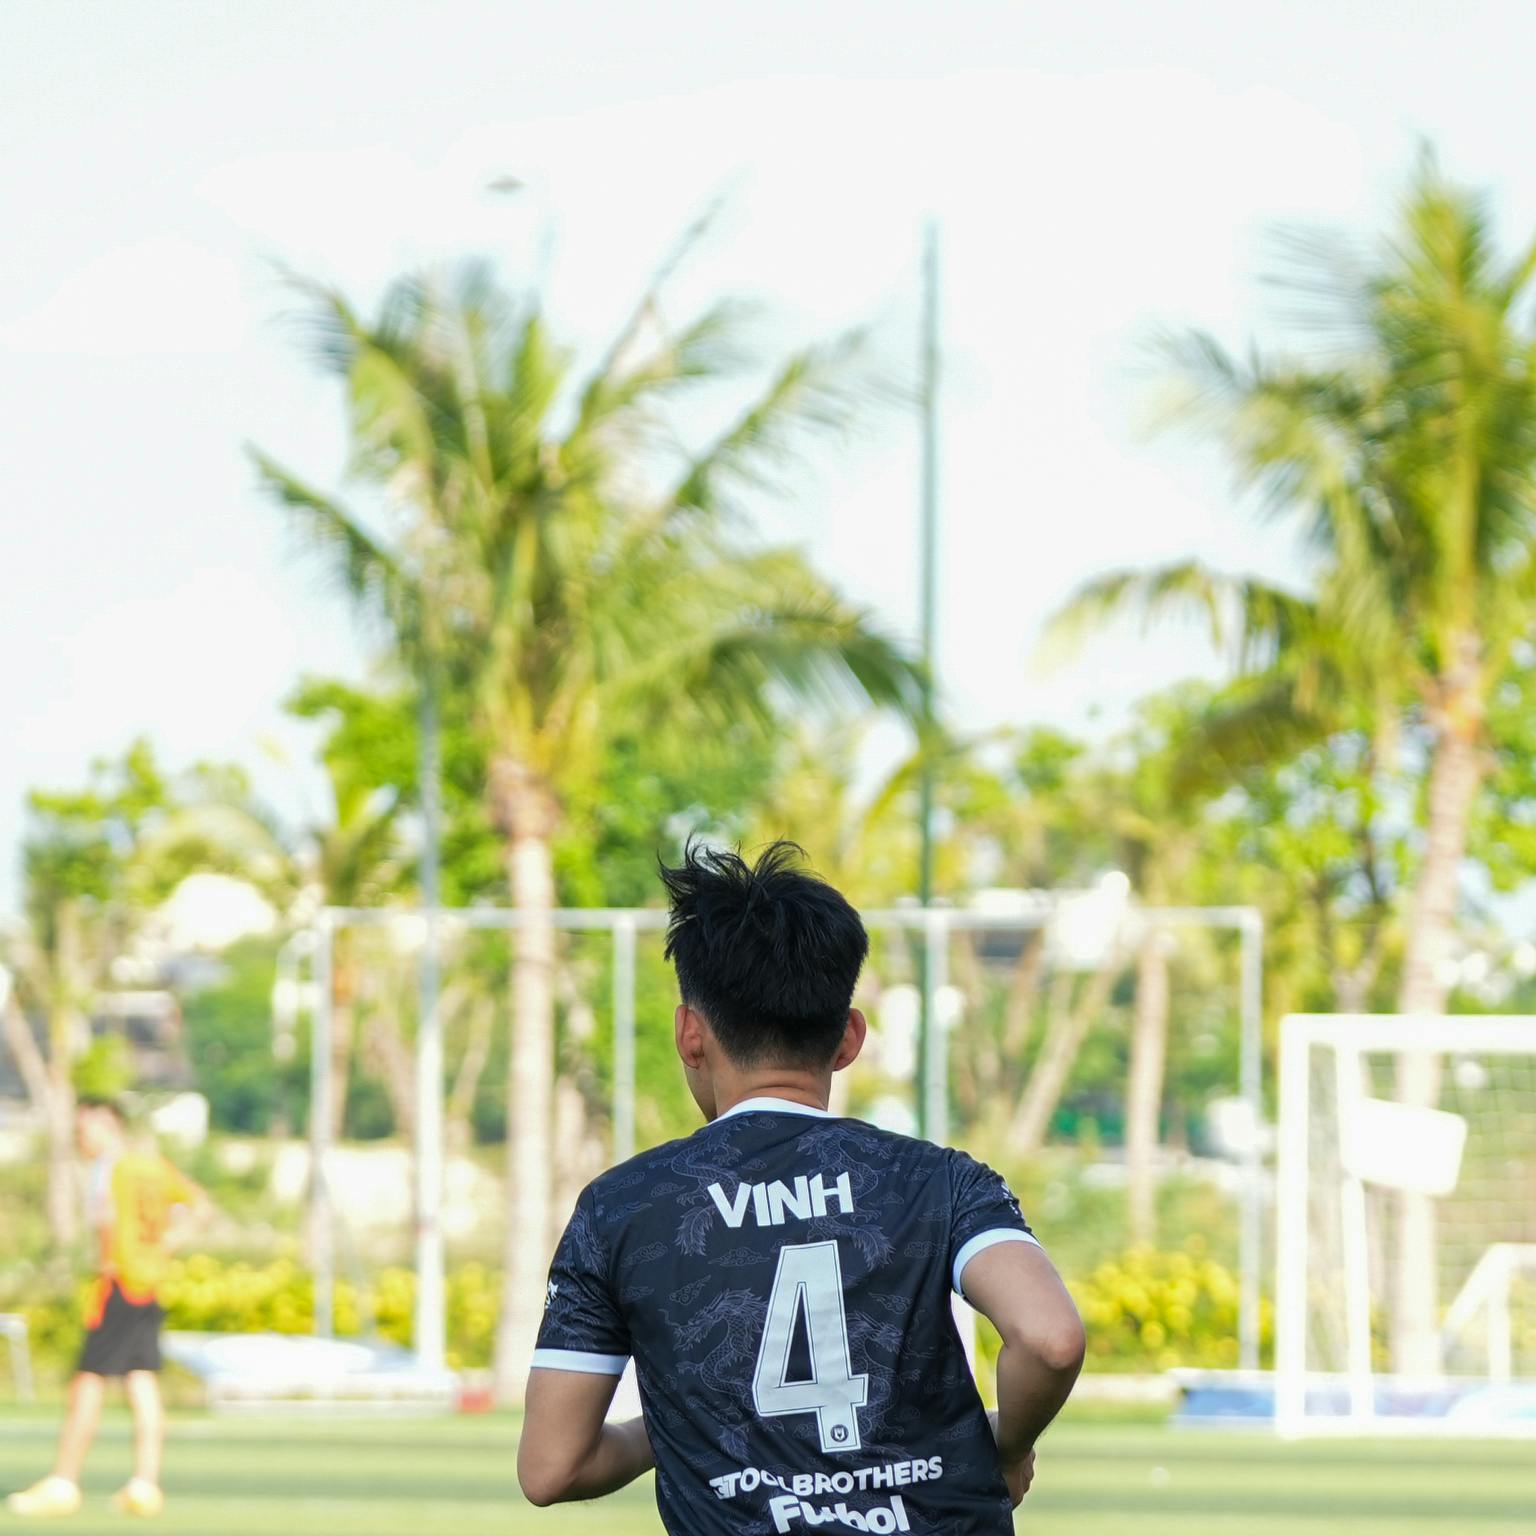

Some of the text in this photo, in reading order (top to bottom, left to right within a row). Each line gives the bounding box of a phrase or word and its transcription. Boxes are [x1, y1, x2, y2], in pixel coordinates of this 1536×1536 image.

[707, 1171, 855, 1228] VINH
[752, 1239, 868, 1453] 4
[768, 1495, 911, 1535] Fubol
